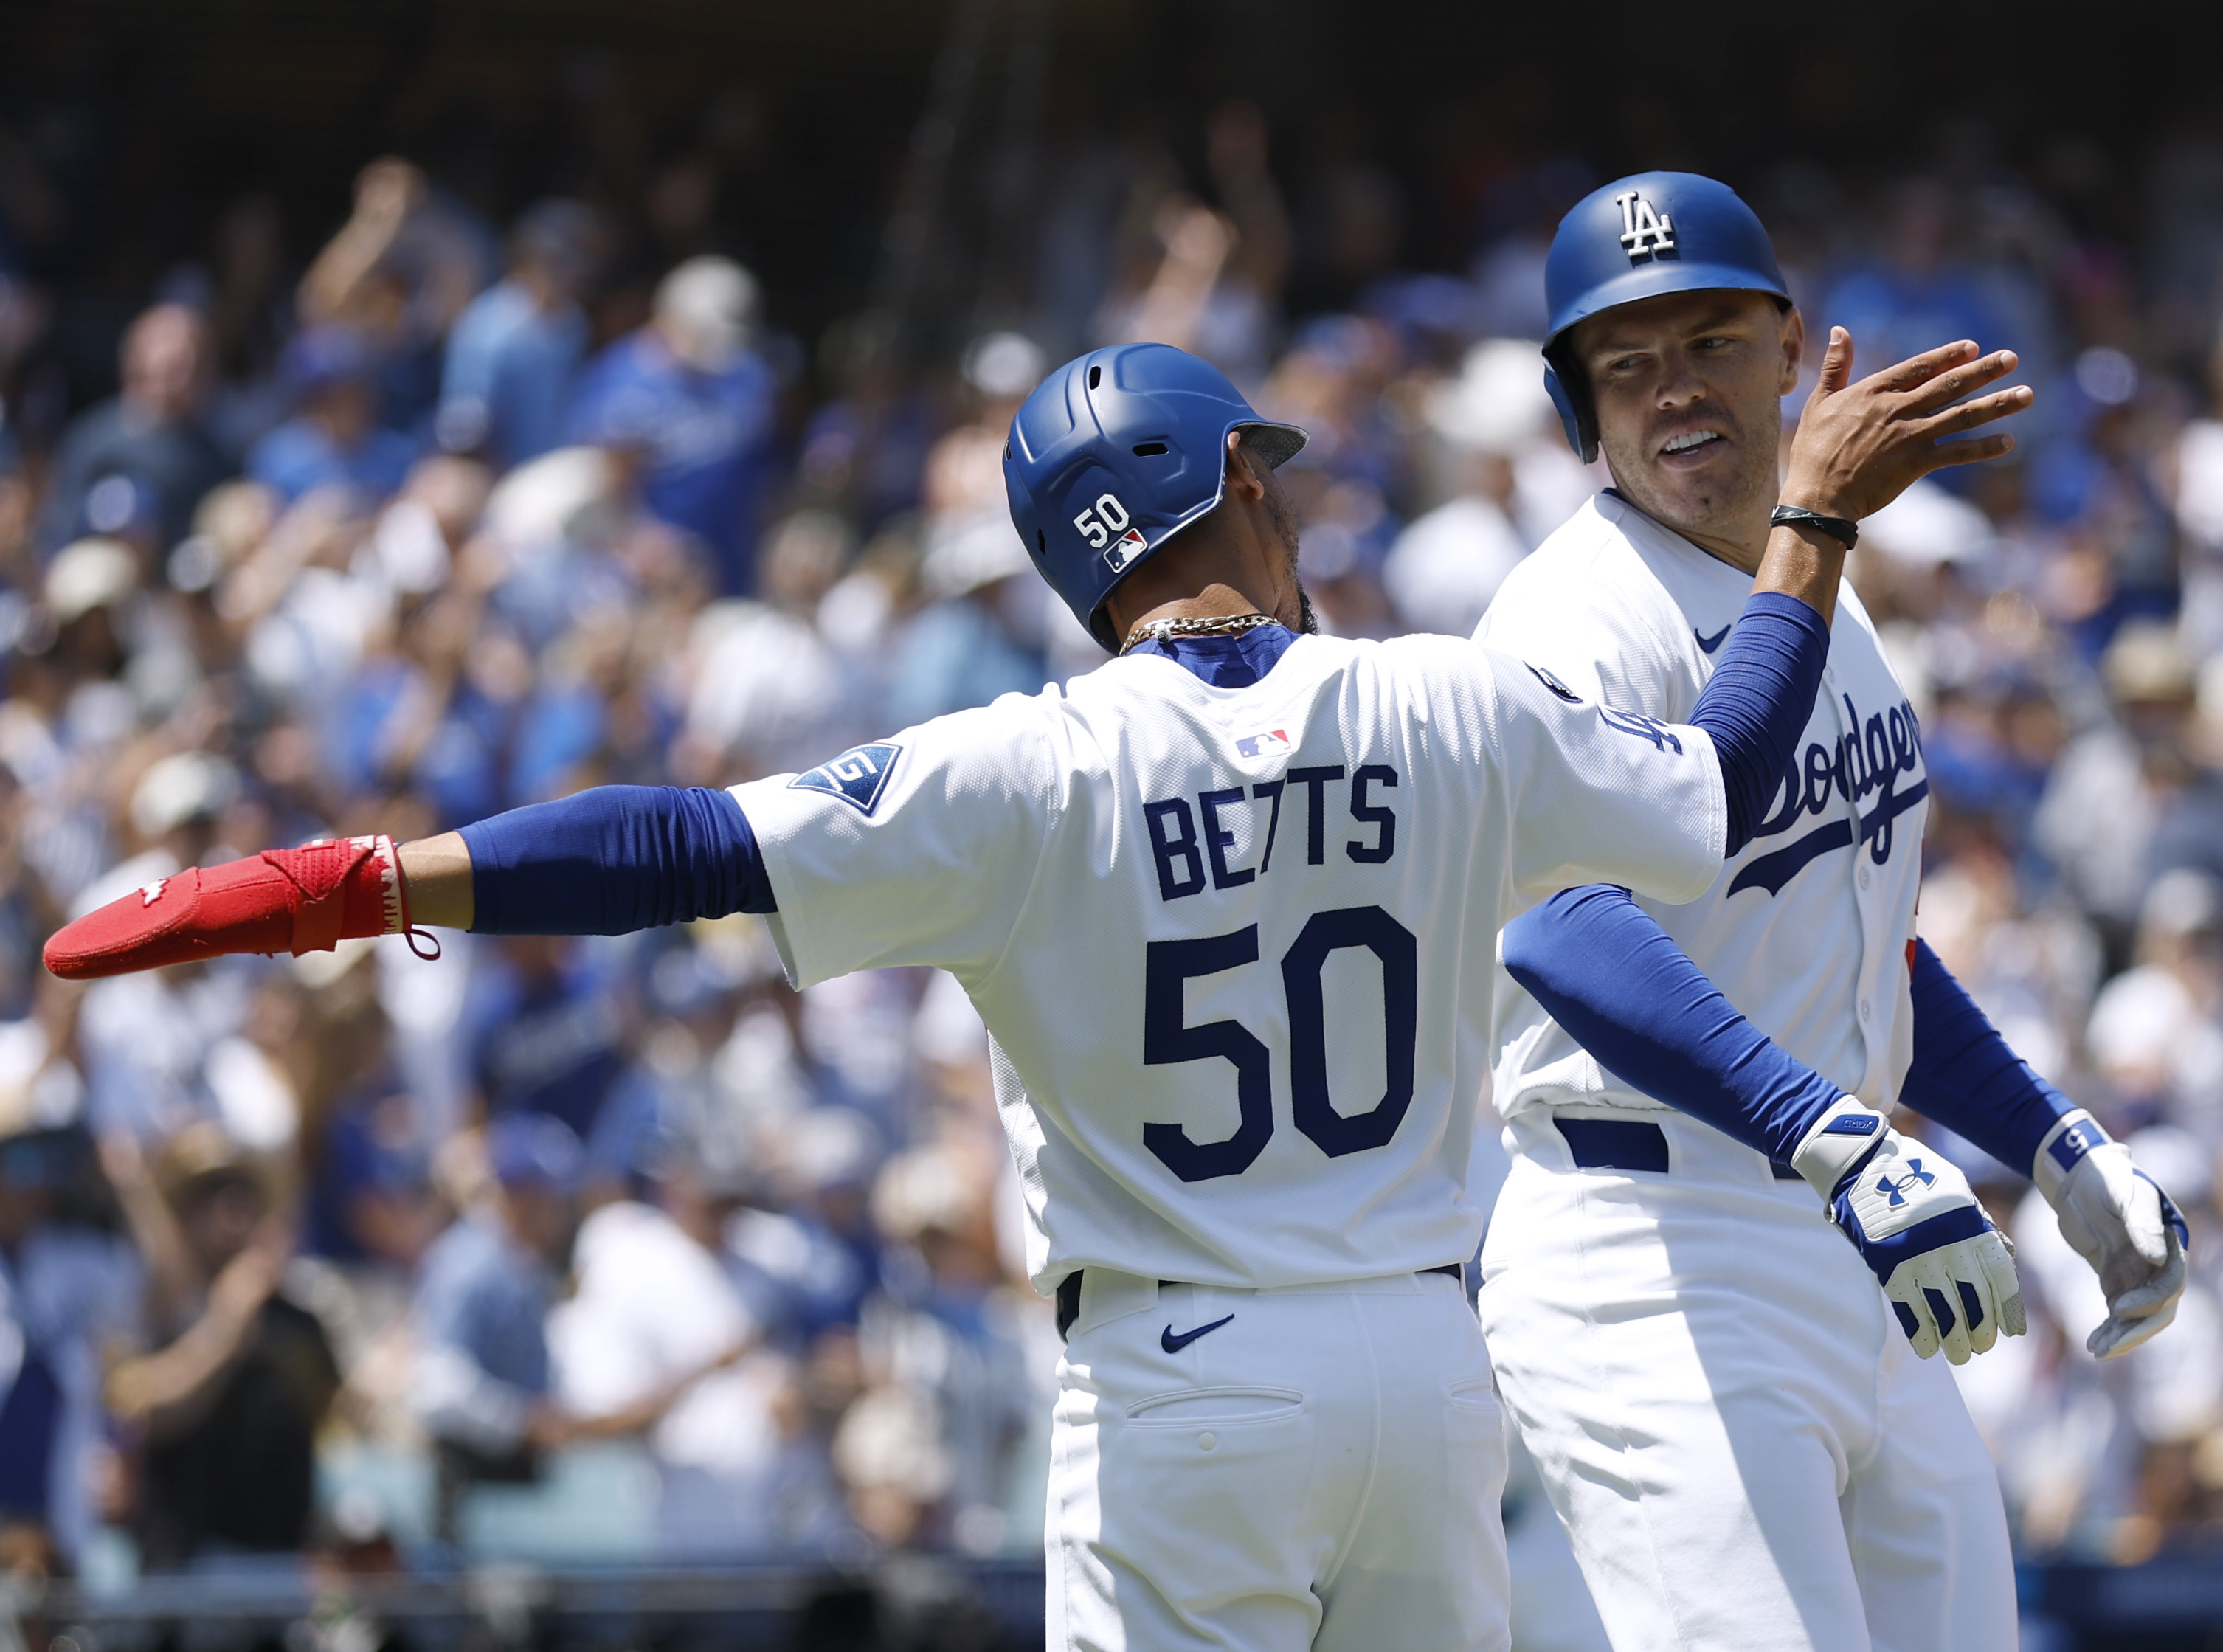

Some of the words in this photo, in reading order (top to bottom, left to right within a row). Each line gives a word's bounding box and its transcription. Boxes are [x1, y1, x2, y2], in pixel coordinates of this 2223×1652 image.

[1616, 192, 1676, 257] LA
[1073, 494, 1130, 548] 50
[1143, 764, 1398, 902] BETTS
[1143, 905, 1417, 1182] 50
